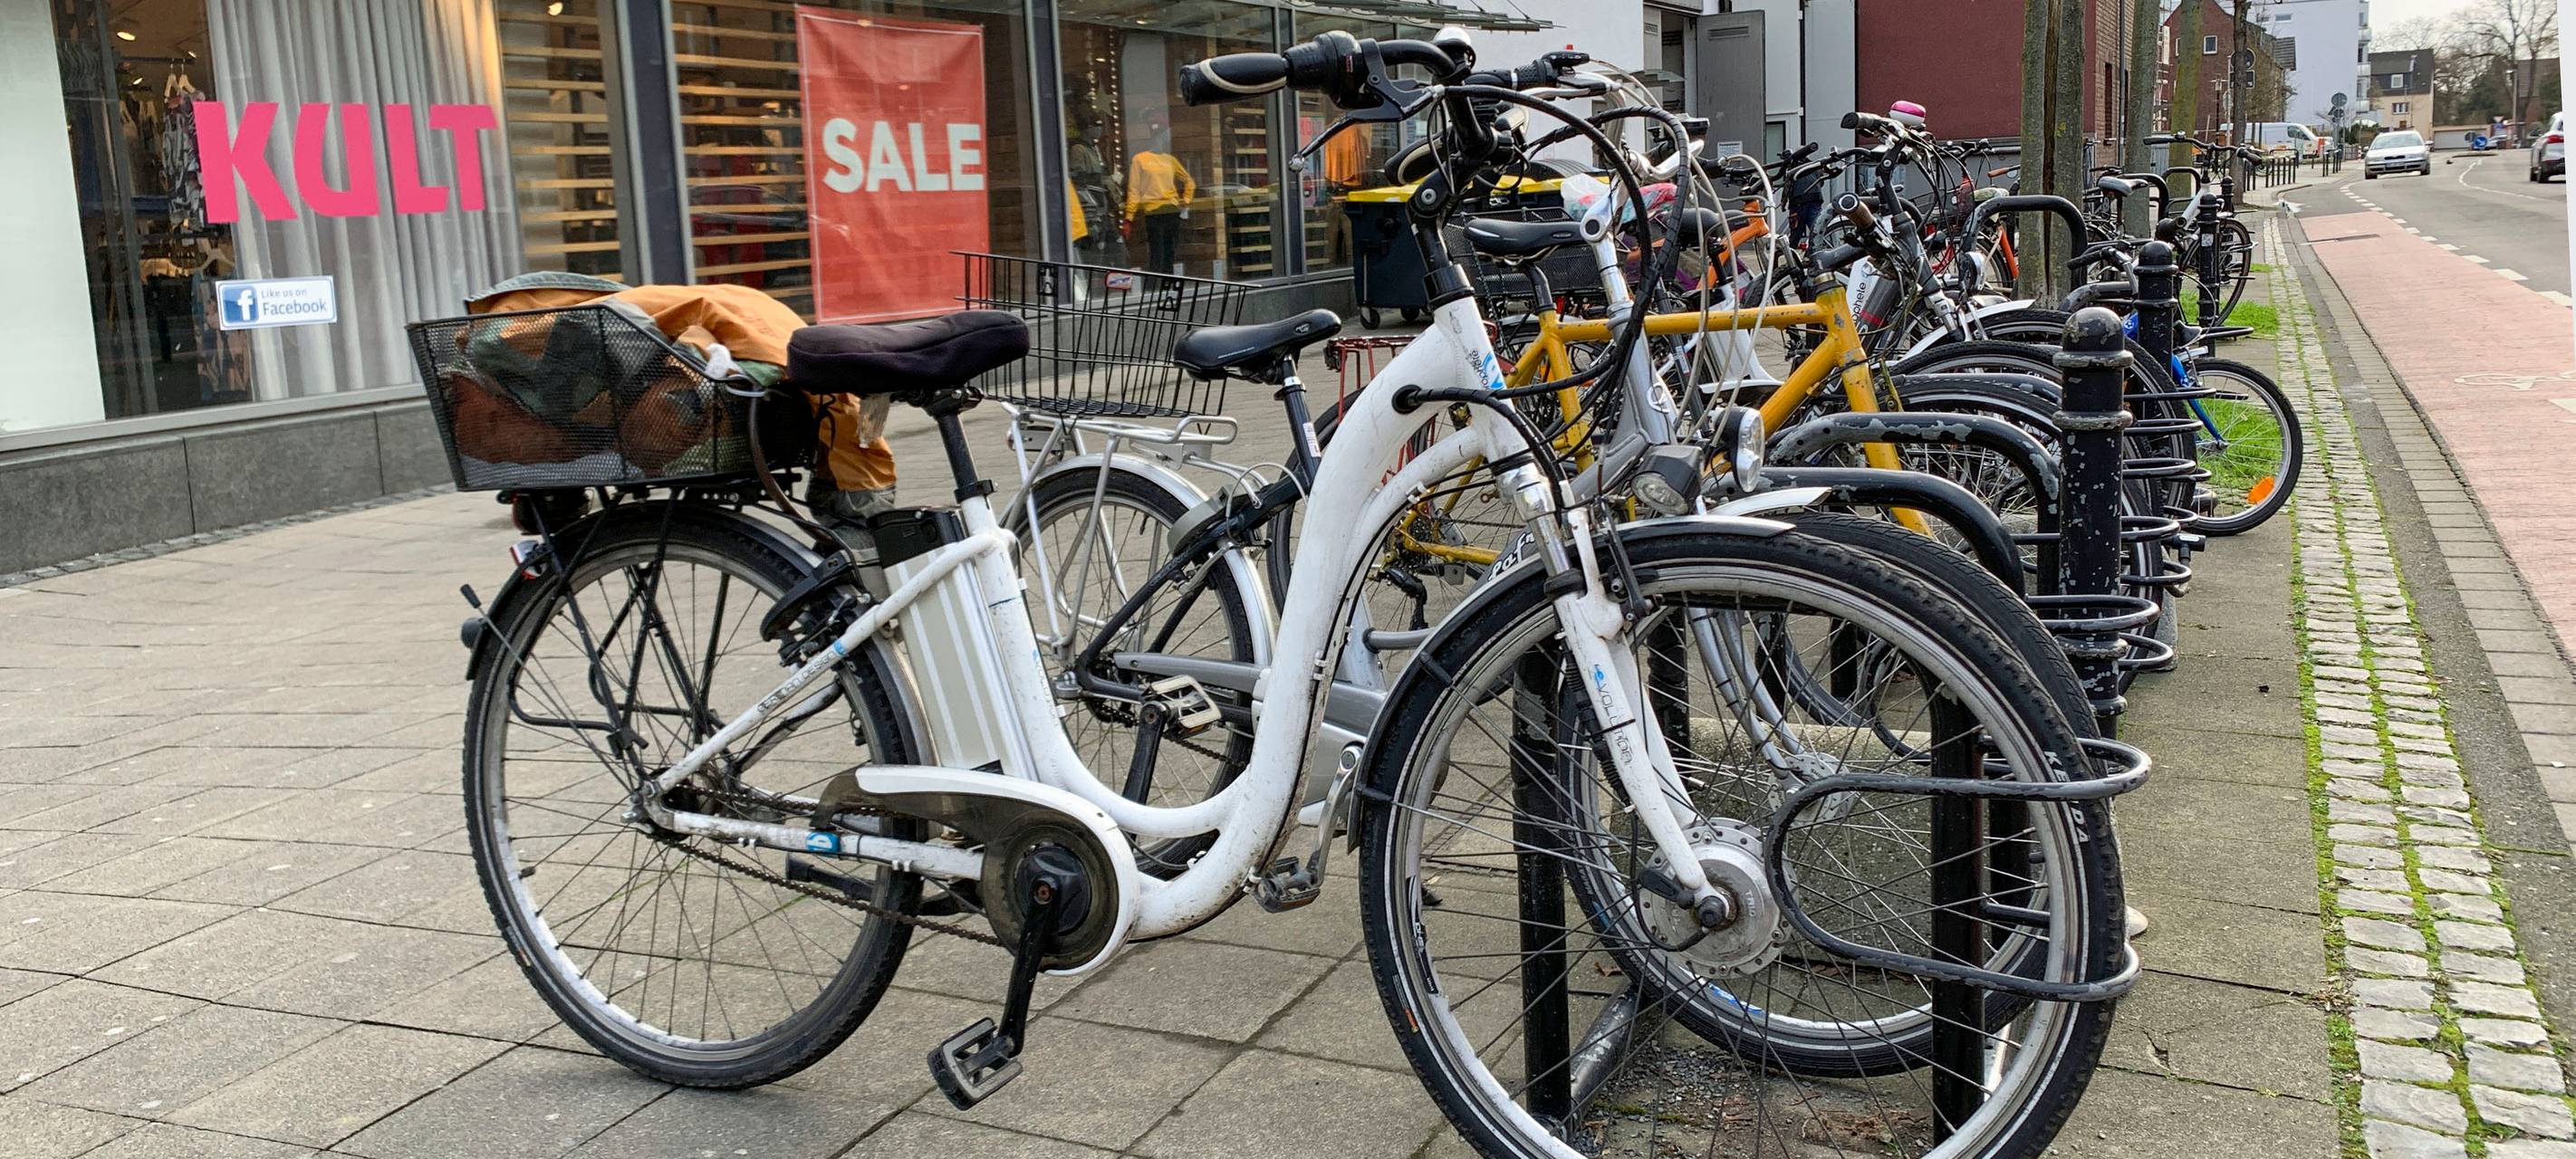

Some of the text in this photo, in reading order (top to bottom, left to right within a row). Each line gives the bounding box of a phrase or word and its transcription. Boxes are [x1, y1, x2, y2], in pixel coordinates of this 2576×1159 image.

[193, 101, 496, 224] KULT
[822, 118, 985, 194] SALE
[261, 288, 307, 299] Like us on
[263, 299, 326, 316] Facebook
[1852, 282, 1868, 321] ophete
[1470, 348, 1491, 389] rophete
[2044, 751, 2090, 843] KEDA
